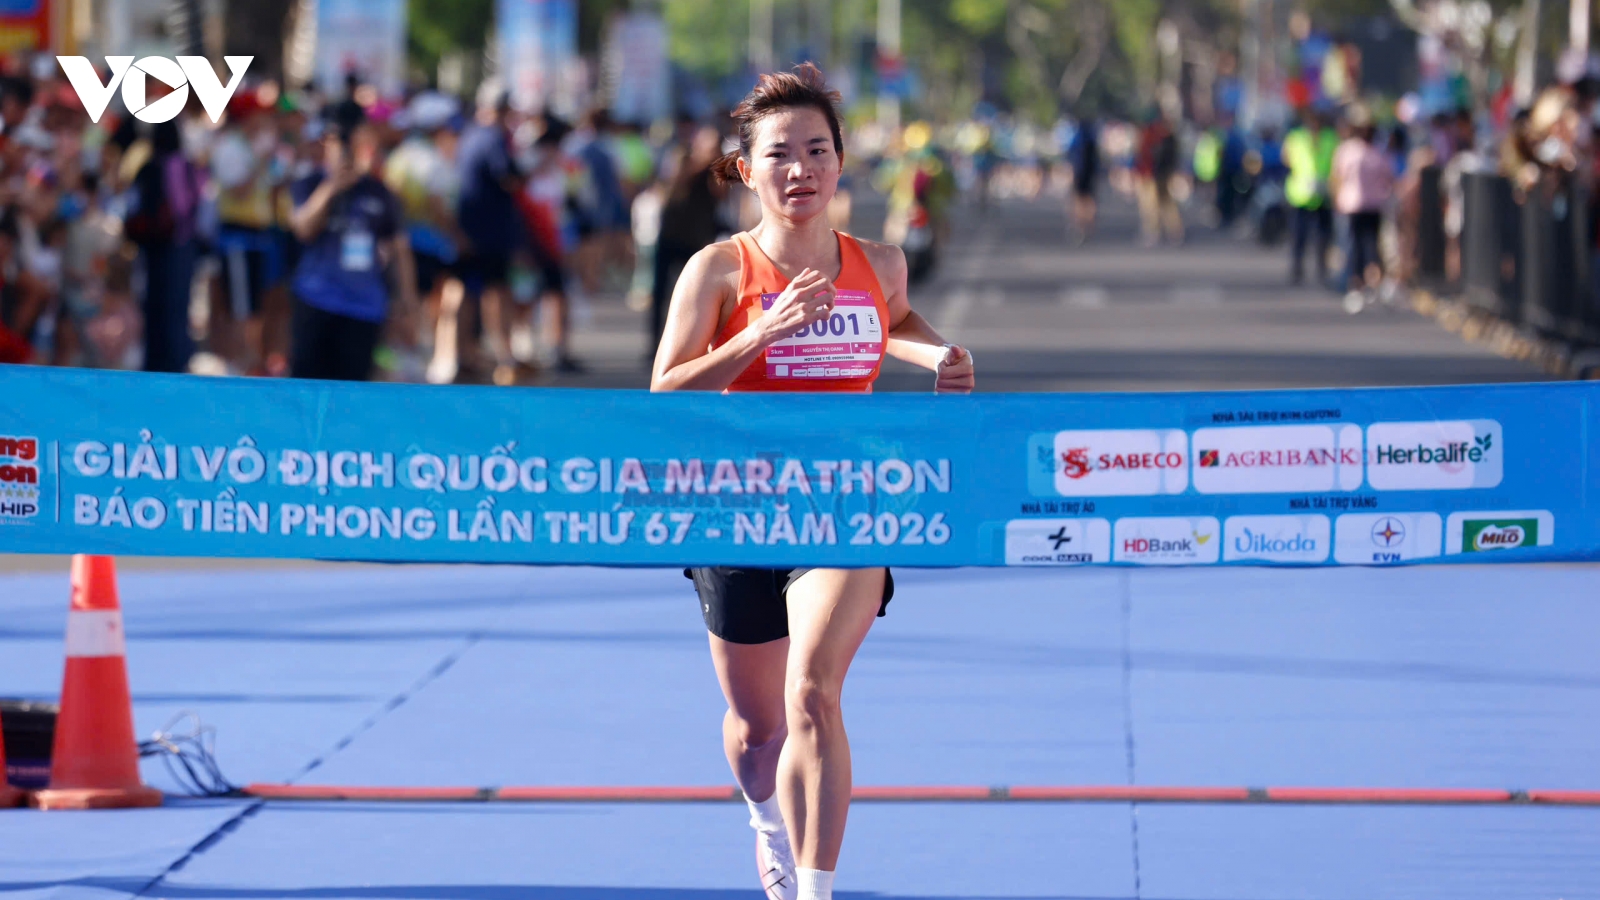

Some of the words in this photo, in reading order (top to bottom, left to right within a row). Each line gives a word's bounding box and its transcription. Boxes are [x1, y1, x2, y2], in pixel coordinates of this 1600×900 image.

[73, 429, 178, 480] GIẢI
[191, 434, 266, 482] VÔ
[279, 449, 394, 496] ĐỊCH
[408, 441, 548, 493] QUỐC
[561, 458, 650, 493] GIA
[664, 459, 951, 494] MARATHON
[1099, 452, 1183, 470] SABECO
[1225, 448, 1354, 468] AGRIBANK
[1377, 443, 1483, 465] Herbalife
[74, 486, 168, 529] BÁO
[177, 486, 269, 534] TIỀN
[280, 503, 437, 541] PHONG
[447, 496, 533, 542] LẦN
[544, 502, 635, 544] THỨ
[645, 512, 695, 545] 67
[733, 503, 838, 545] NĂM
[849, 513, 951, 545] 2026
[1124, 538, 1192, 552] HDBank
[1481, 531, 1519, 544] MILO
[1372, 553, 1401, 561] EVN
